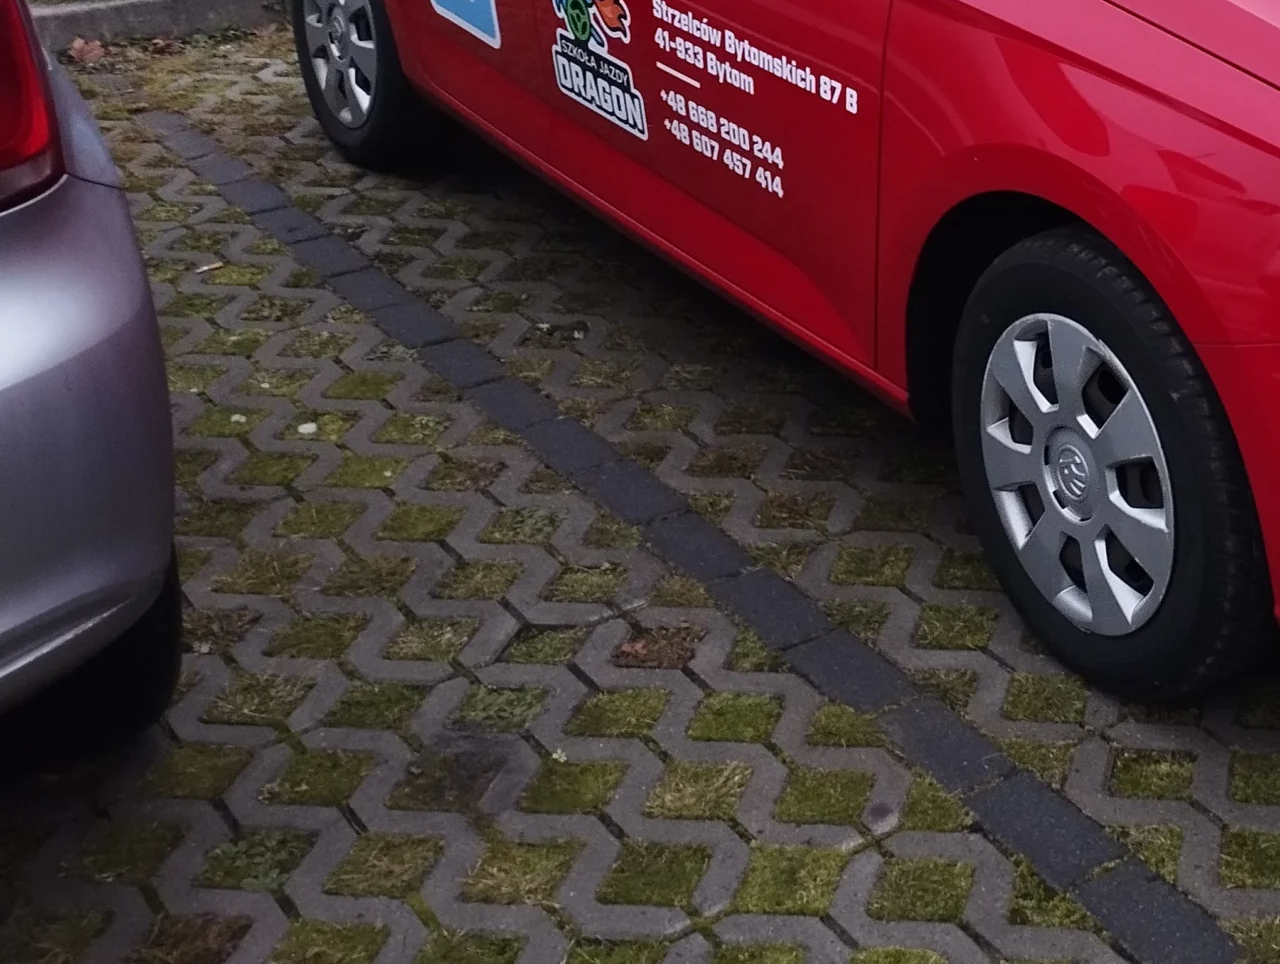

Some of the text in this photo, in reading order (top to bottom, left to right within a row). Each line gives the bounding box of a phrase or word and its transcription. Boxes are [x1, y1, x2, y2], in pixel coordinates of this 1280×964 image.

[556, 54, 643, 131] DRAGON
[561, 40, 629, 86] SZKOŁA JAZDY
[654, 28, 755, 95] 41-933 Bytom
[724, 29, 816, 94] Bytomskich
[819, 75, 842, 104] 87
[846, 87, 858, 114] B
[660, 90, 784, 169] +48 668 200 244
[664, 118, 784, 198] +48 607 457 414
